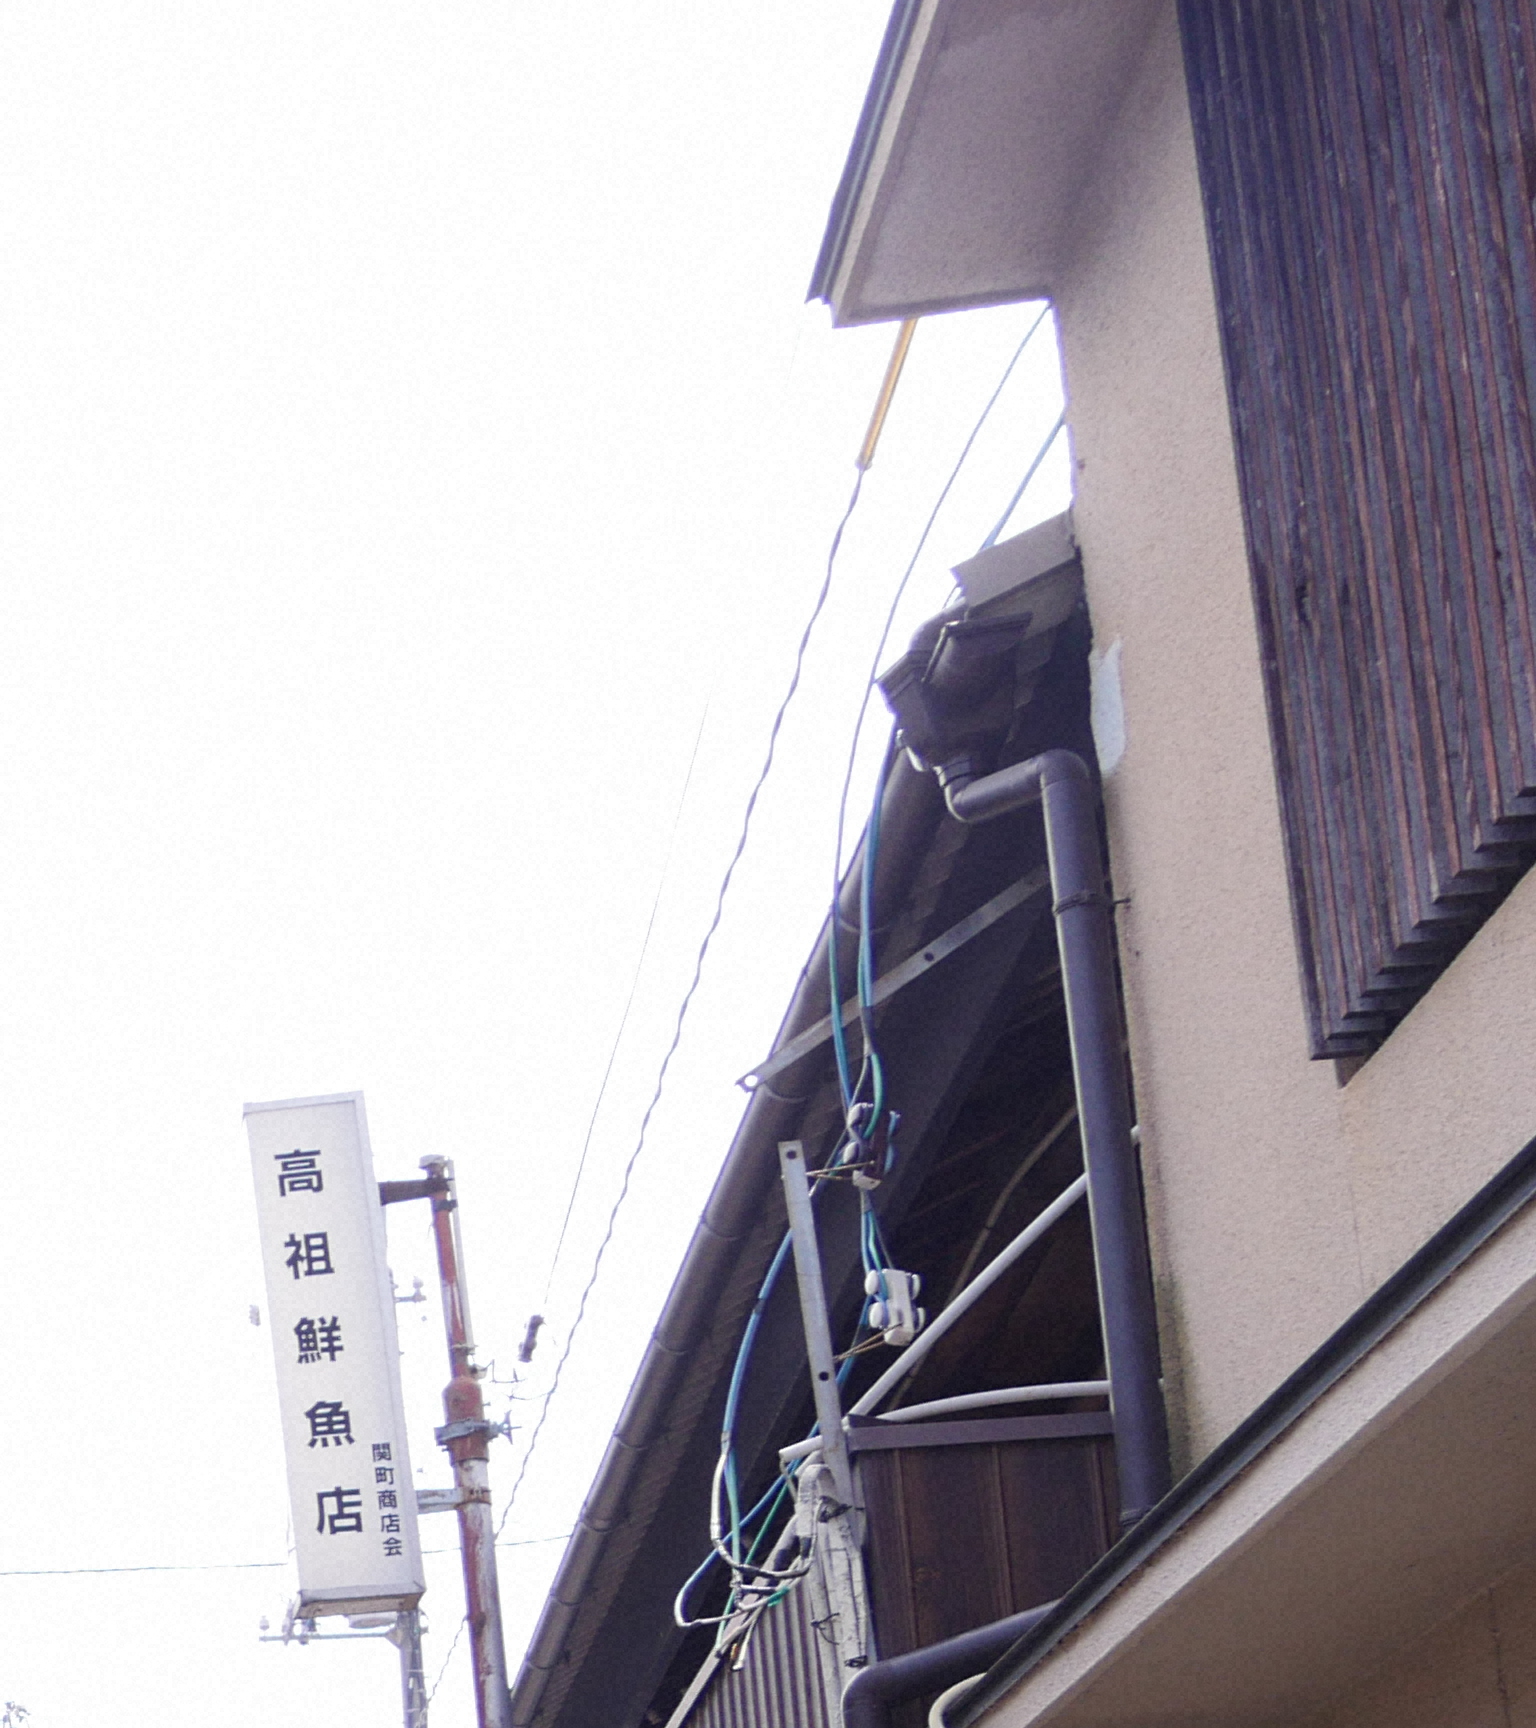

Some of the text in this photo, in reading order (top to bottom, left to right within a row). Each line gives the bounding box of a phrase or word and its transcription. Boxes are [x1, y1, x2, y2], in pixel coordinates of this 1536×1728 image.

[274, 1148, 364, 1535] 高祖鮮魚店
[371, 1442, 403, 1557] 関町商店会
